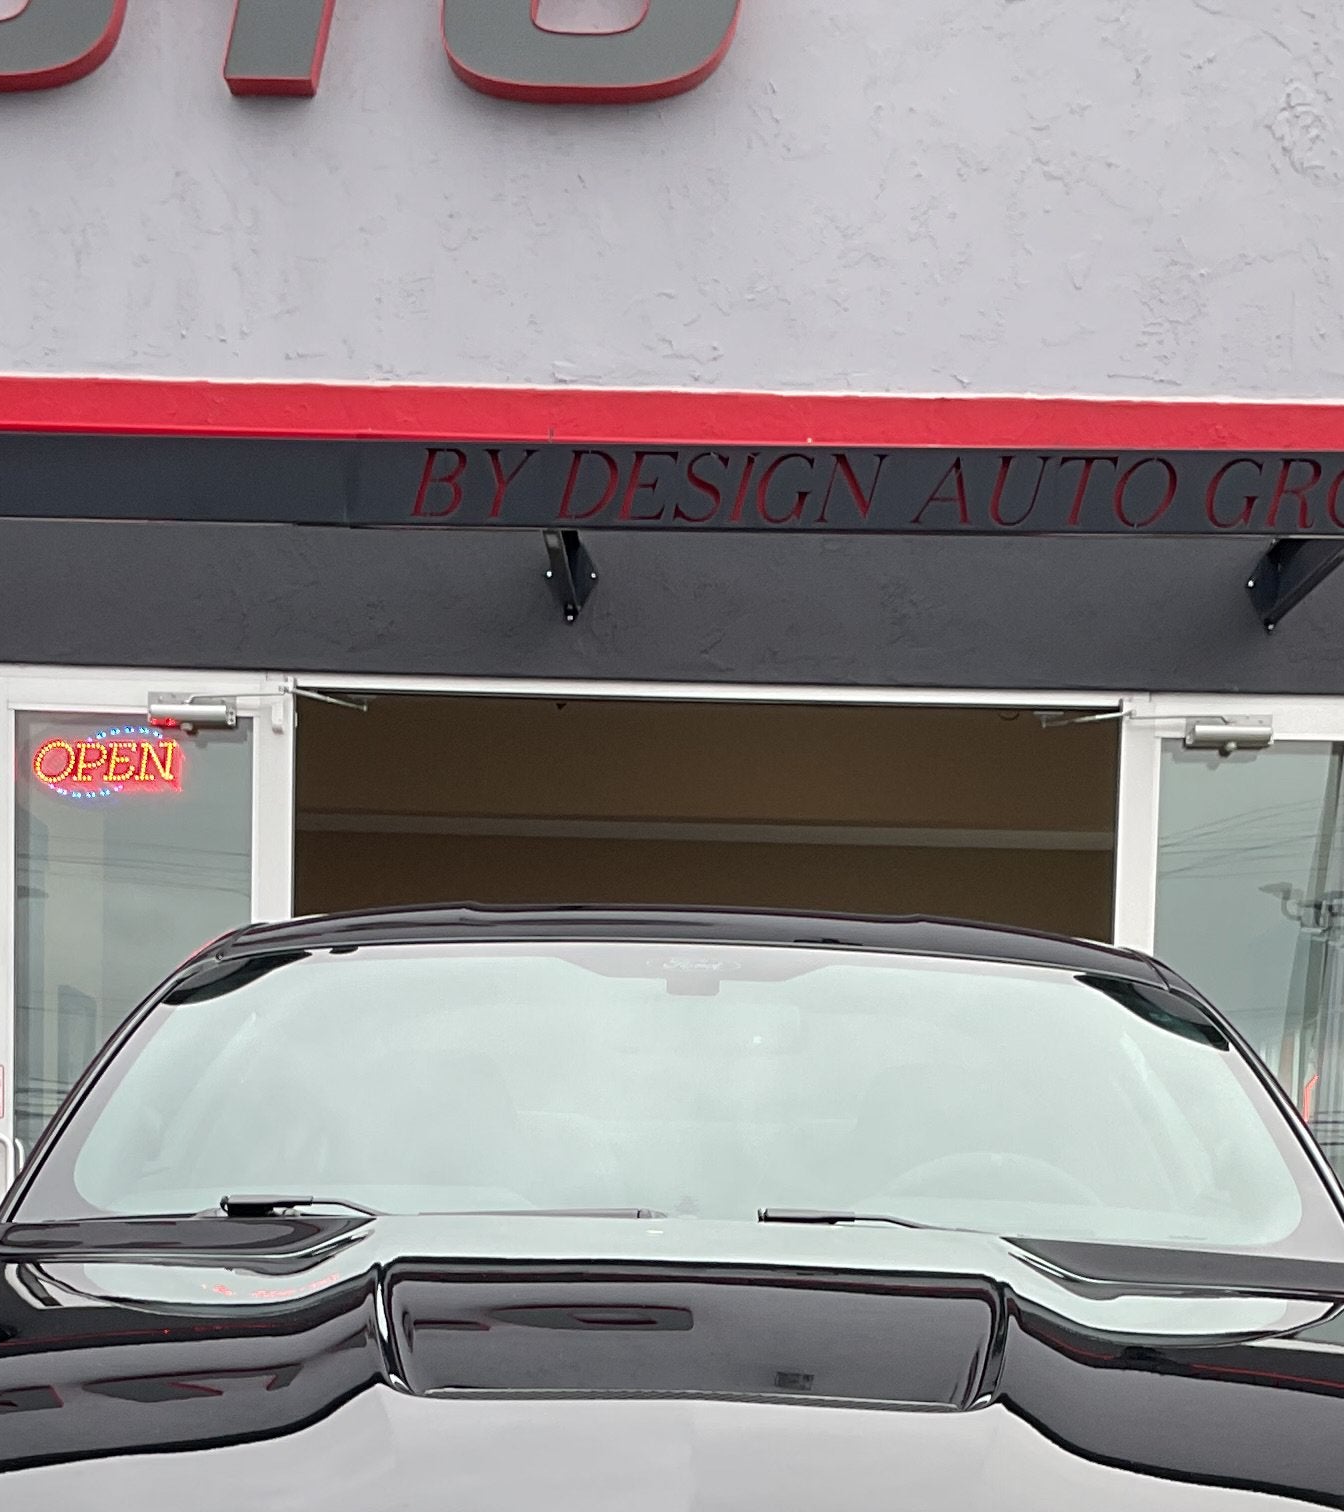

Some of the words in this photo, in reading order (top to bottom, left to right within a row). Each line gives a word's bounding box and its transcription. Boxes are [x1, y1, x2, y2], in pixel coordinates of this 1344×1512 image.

[409, 446, 540, 519] BY
[557, 448, 887, 524] DESIGN
[909, 454, 1179, 528] AUTO
[34, 739, 179, 783] OPEN
